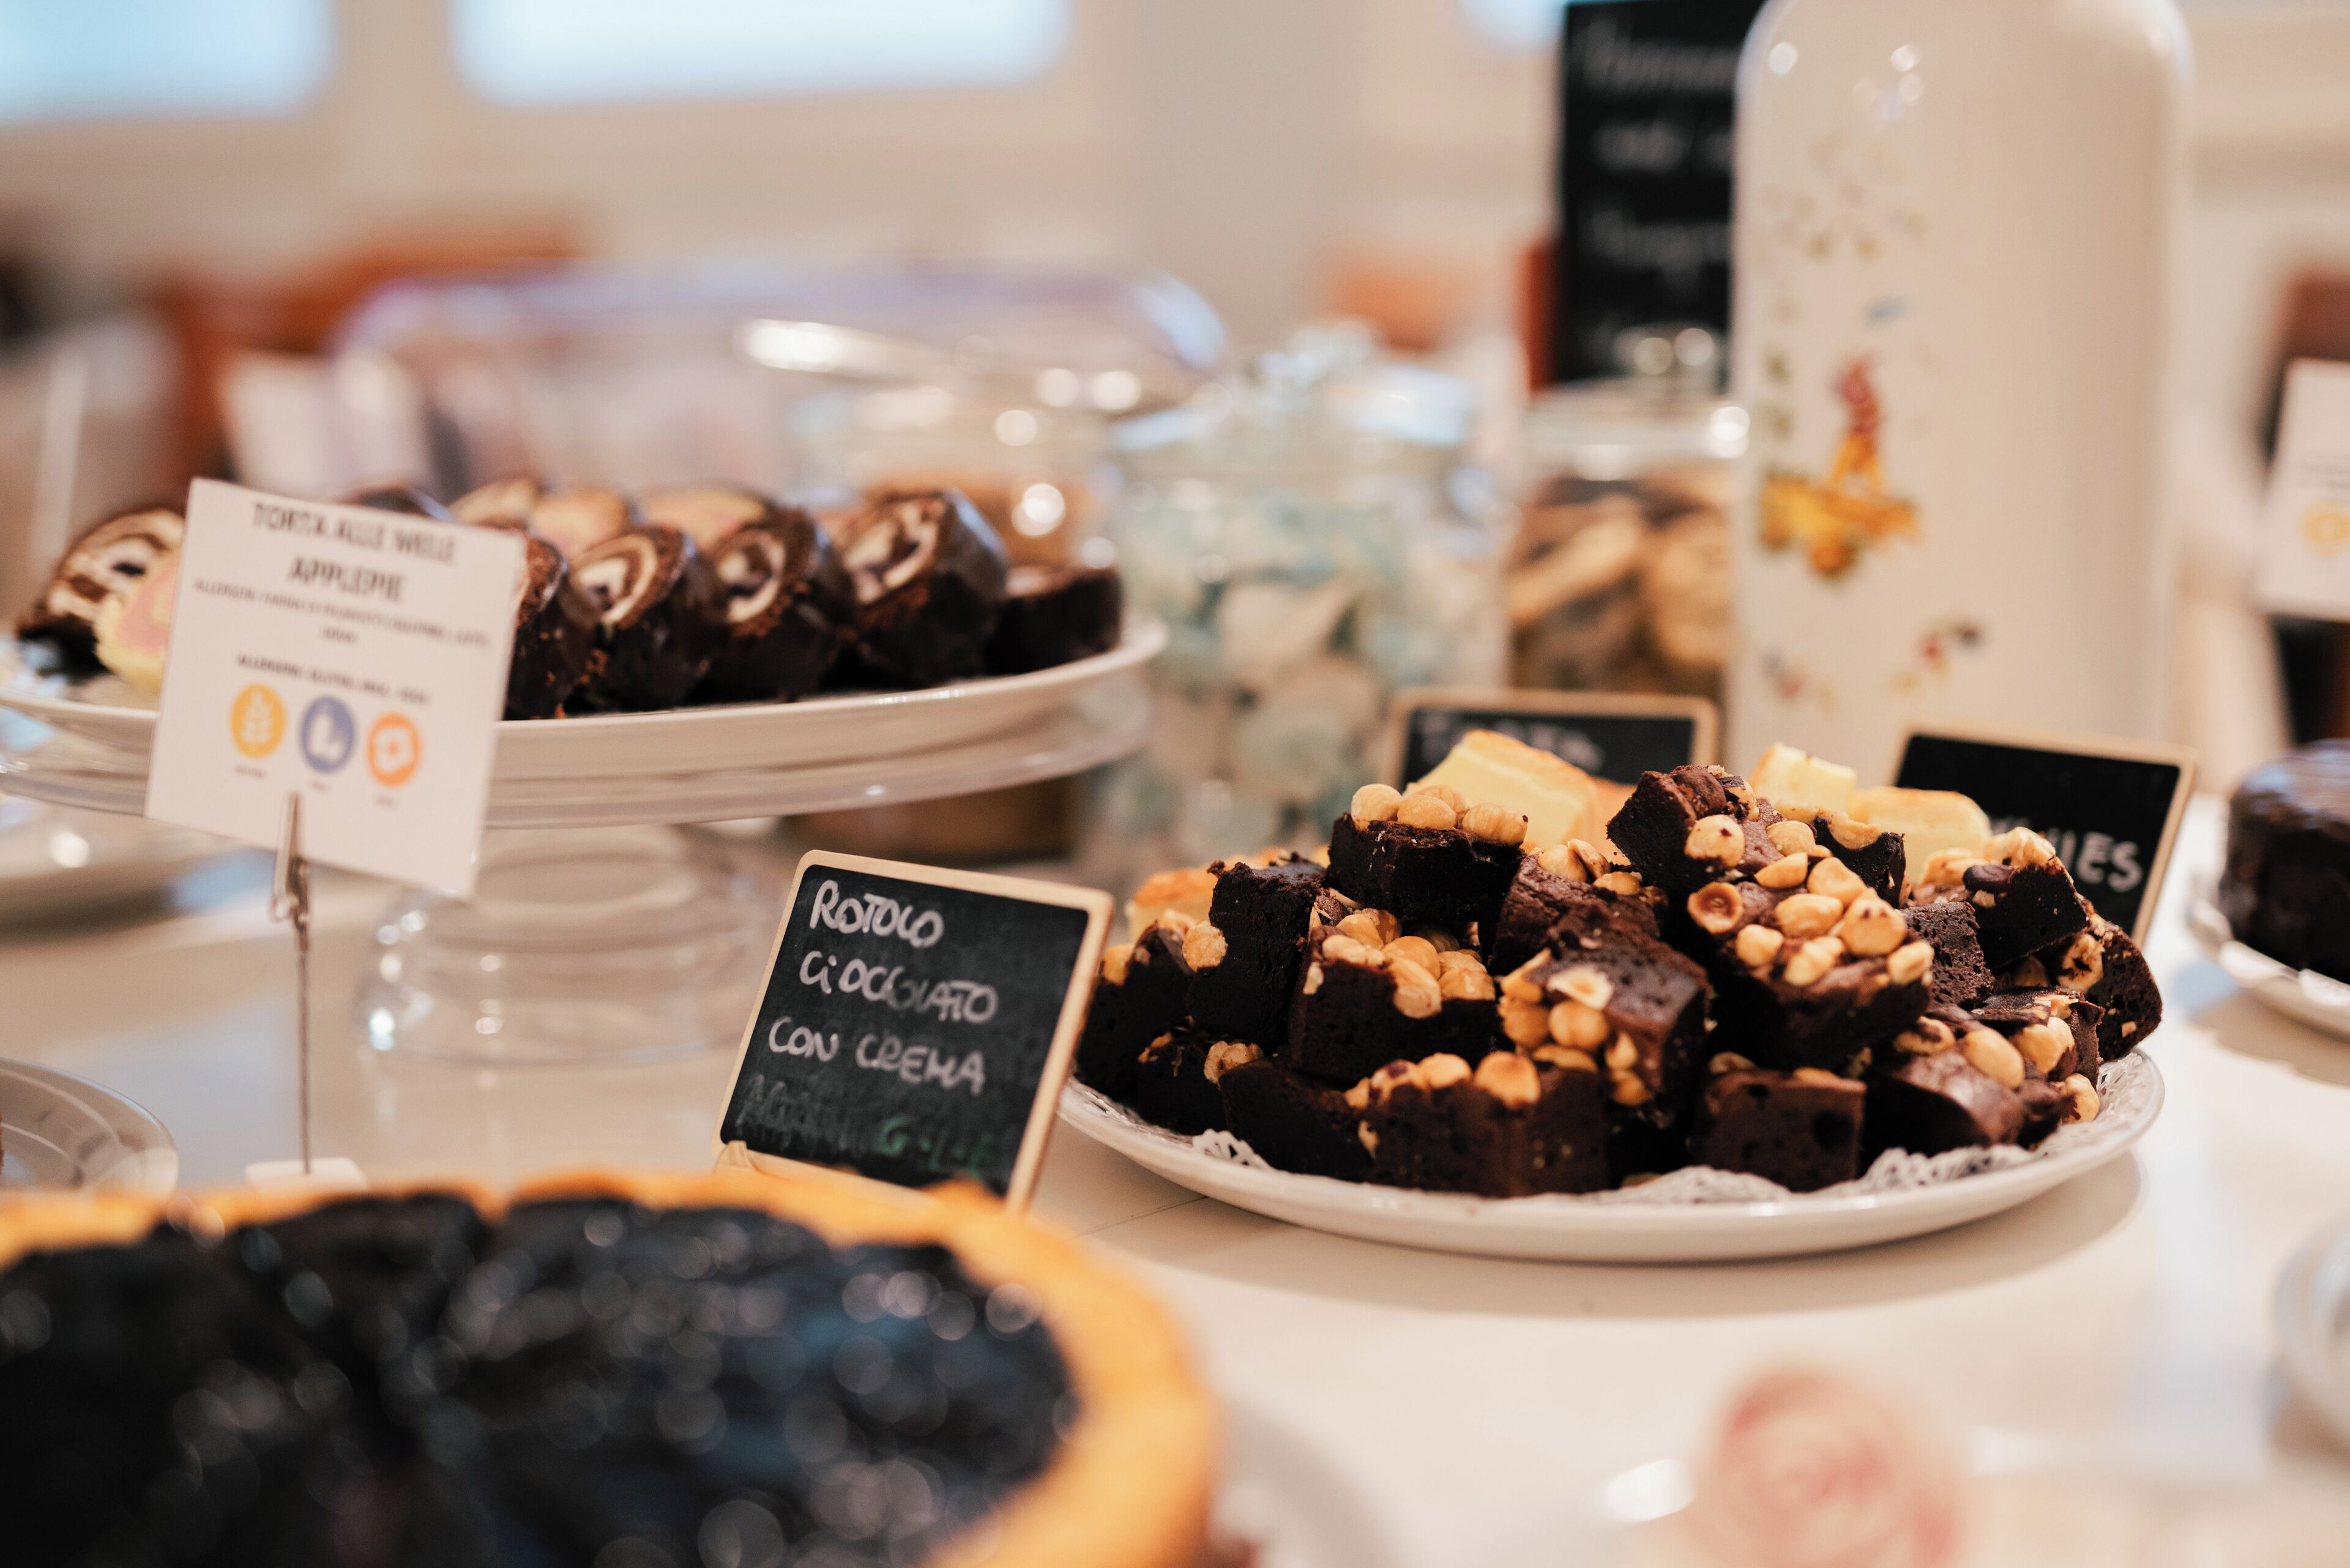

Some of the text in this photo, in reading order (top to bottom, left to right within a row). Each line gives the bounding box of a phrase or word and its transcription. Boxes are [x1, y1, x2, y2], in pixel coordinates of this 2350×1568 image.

[252, 502, 327, 538] TORTA
[334, 517, 385, 550] ALLE
[288, 556, 405, 605] APPLEPIE
[808, 879, 945, 948] ROTOLO
[768, 1015, 987, 1097] CON CREMA
